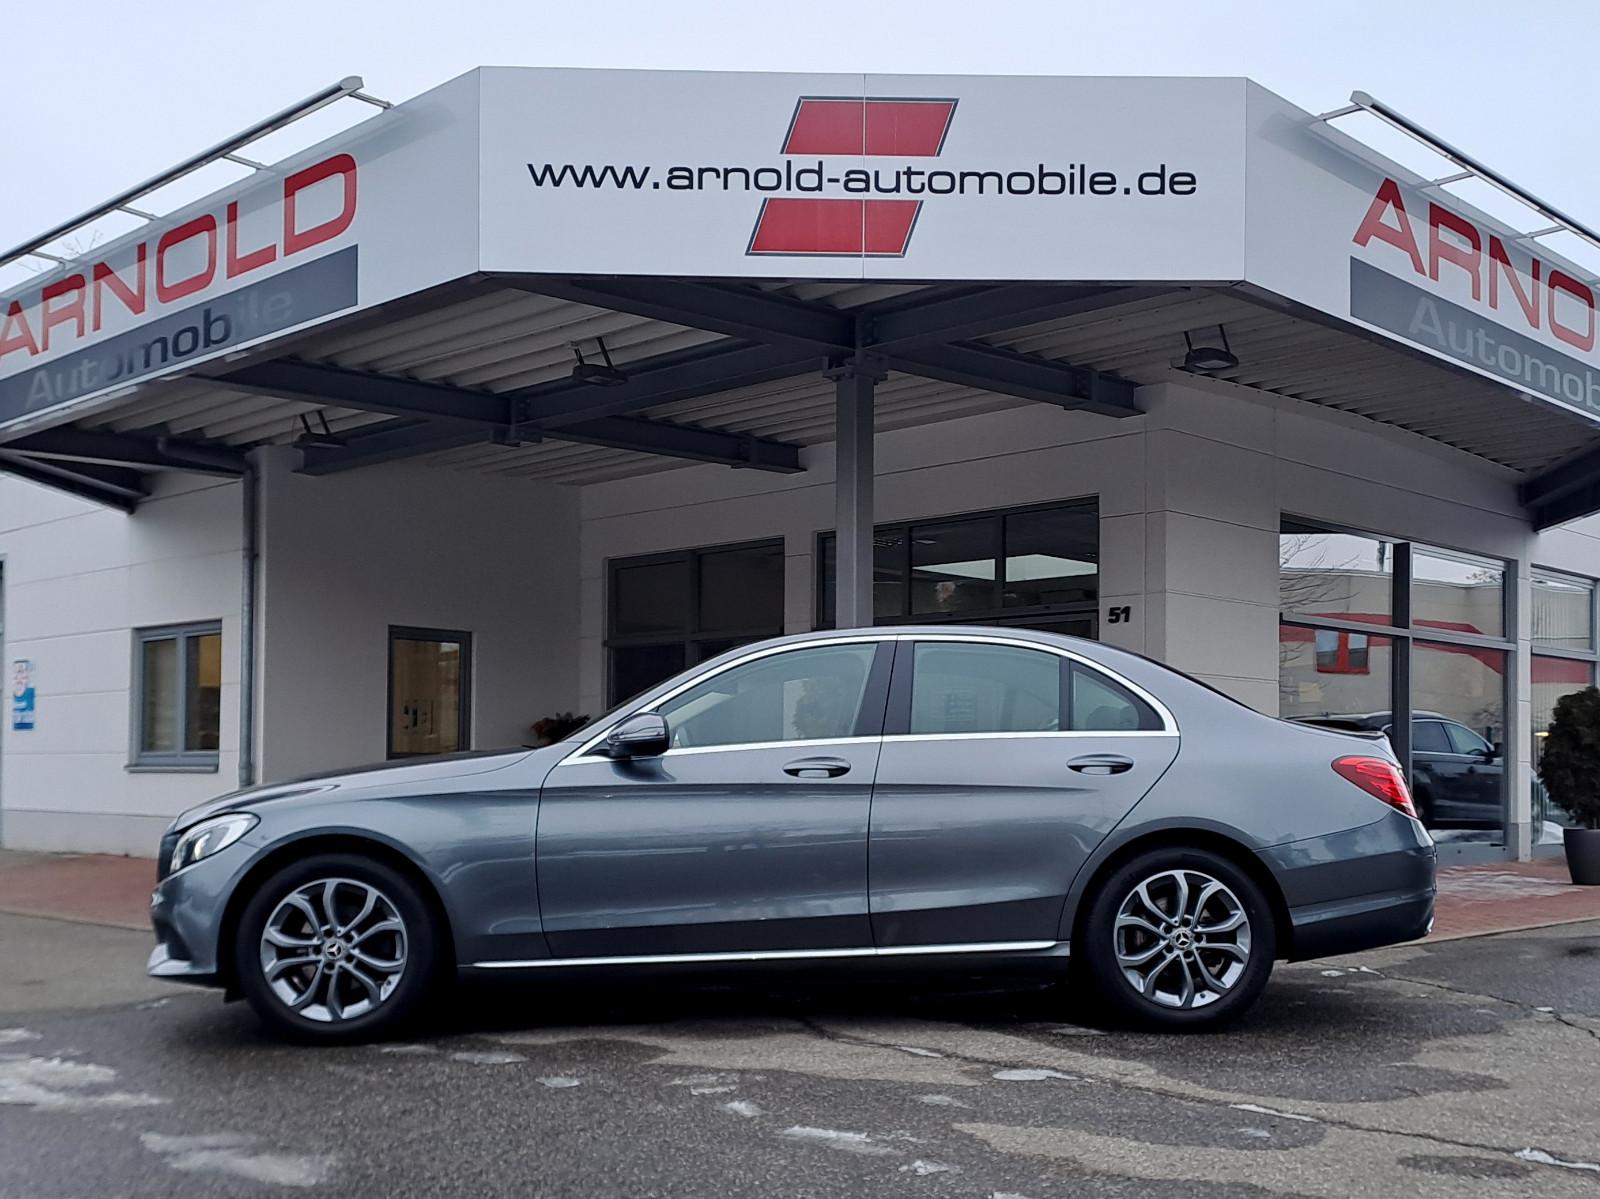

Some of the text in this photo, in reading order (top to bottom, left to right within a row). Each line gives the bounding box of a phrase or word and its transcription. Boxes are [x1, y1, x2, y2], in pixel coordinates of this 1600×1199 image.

[527, 160, 1197, 196] www.arnold-automobile.de
[0, 153, 357, 356] ARNOLD
[1108, 606, 1131, 624] 51
